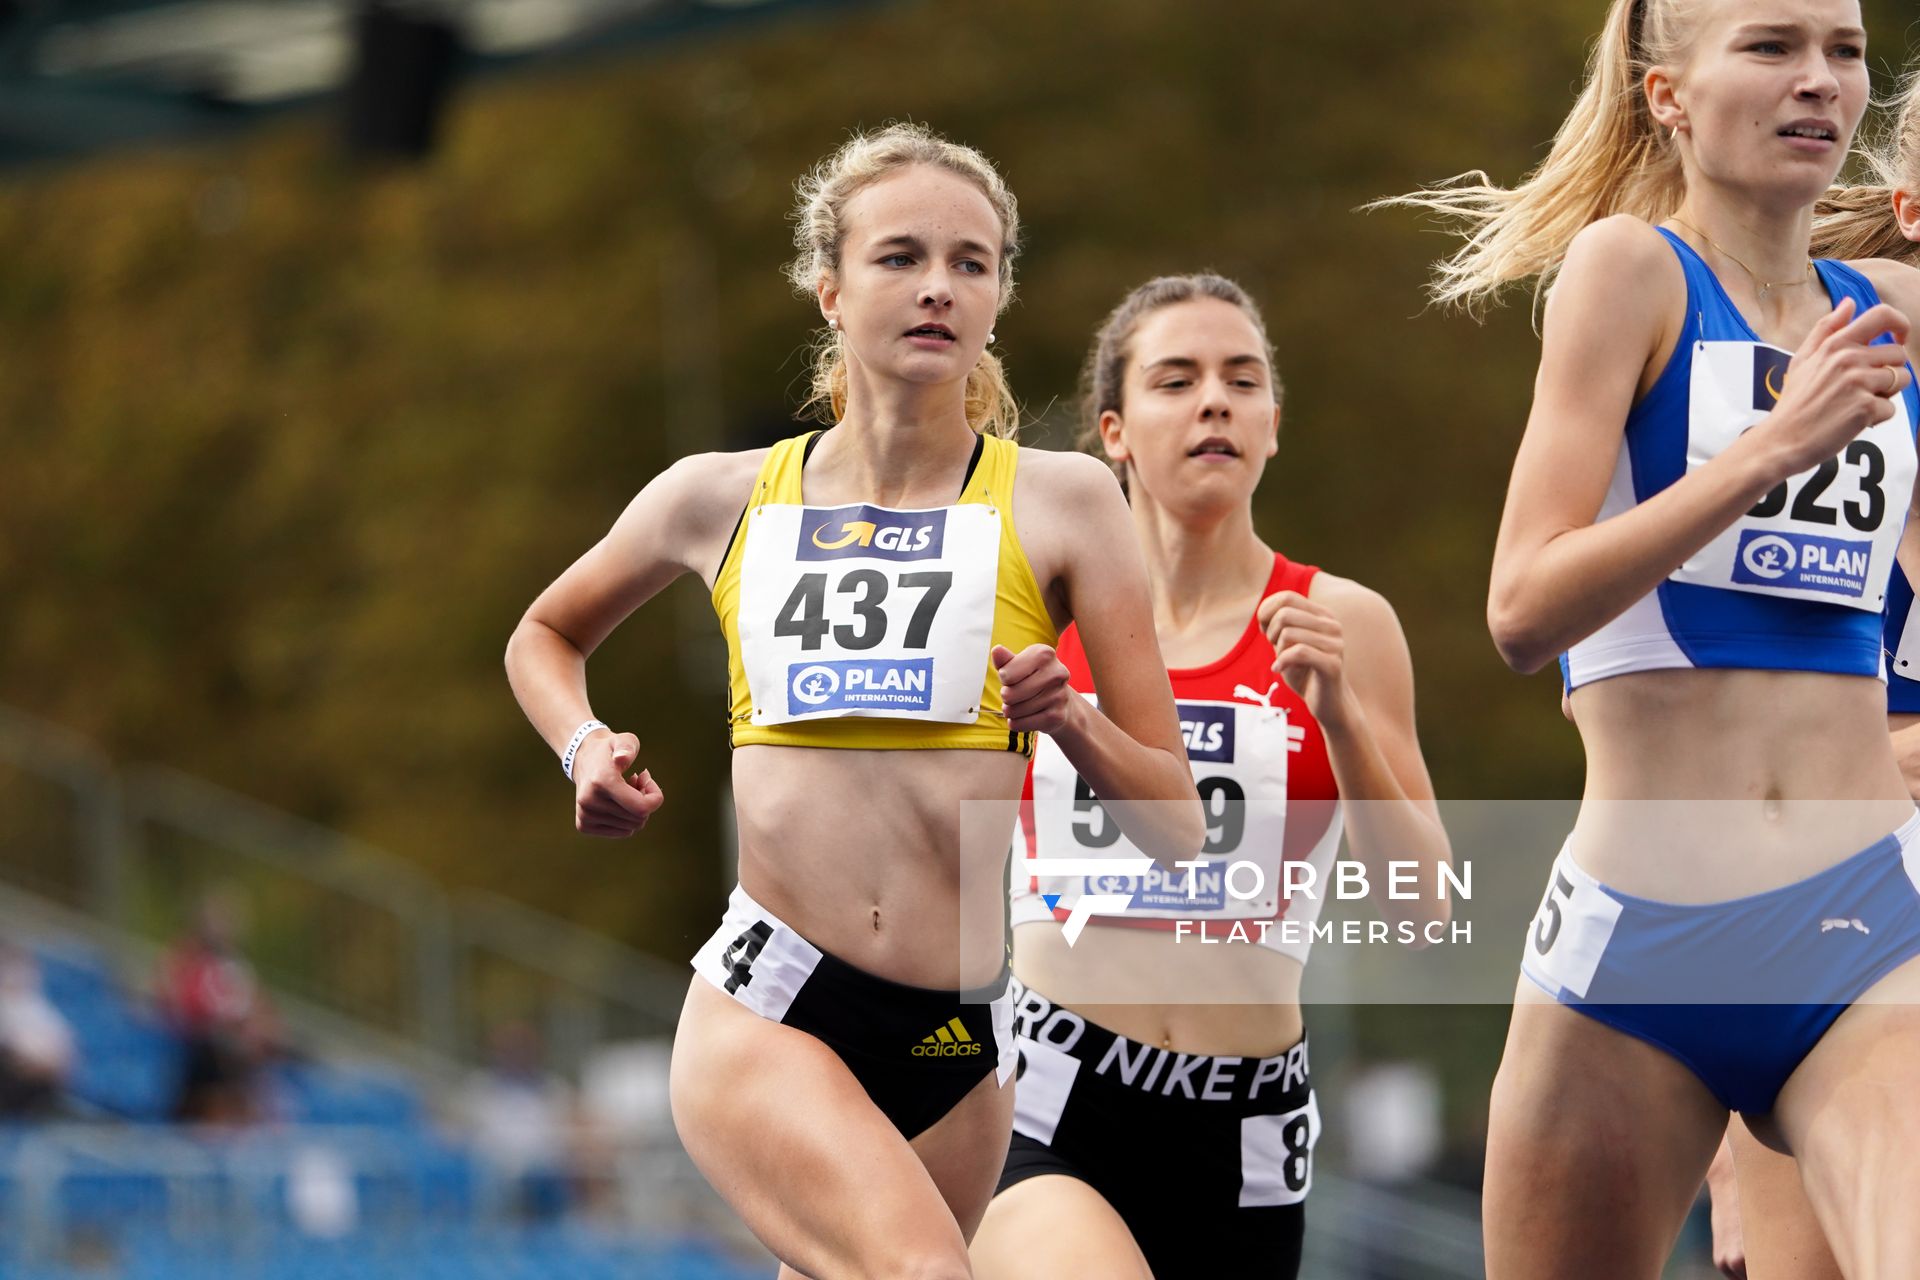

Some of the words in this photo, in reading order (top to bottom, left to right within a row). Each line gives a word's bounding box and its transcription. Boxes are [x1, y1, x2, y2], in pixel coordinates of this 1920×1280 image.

[874, 525, 934, 551] GLS
[1801, 544, 1868, 578] PLAN
[1800, 572, 1862, 591] INTERNATIONAL
[774, 568, 953, 651] 437
[844, 668, 926, 692] PLAN
[844, 694, 924, 704] INTERNATIONAL
[1072, 772, 1245, 854] 59
[1143, 866, 1219, 894] PLAN
[1534, 868, 1575, 956] 5
[722, 920, 774, 995] 4
[911, 1041, 981, 1057] adidas
[1095, 1035, 1242, 1100] NIKE
[1282, 1113, 1310, 1192] 8
